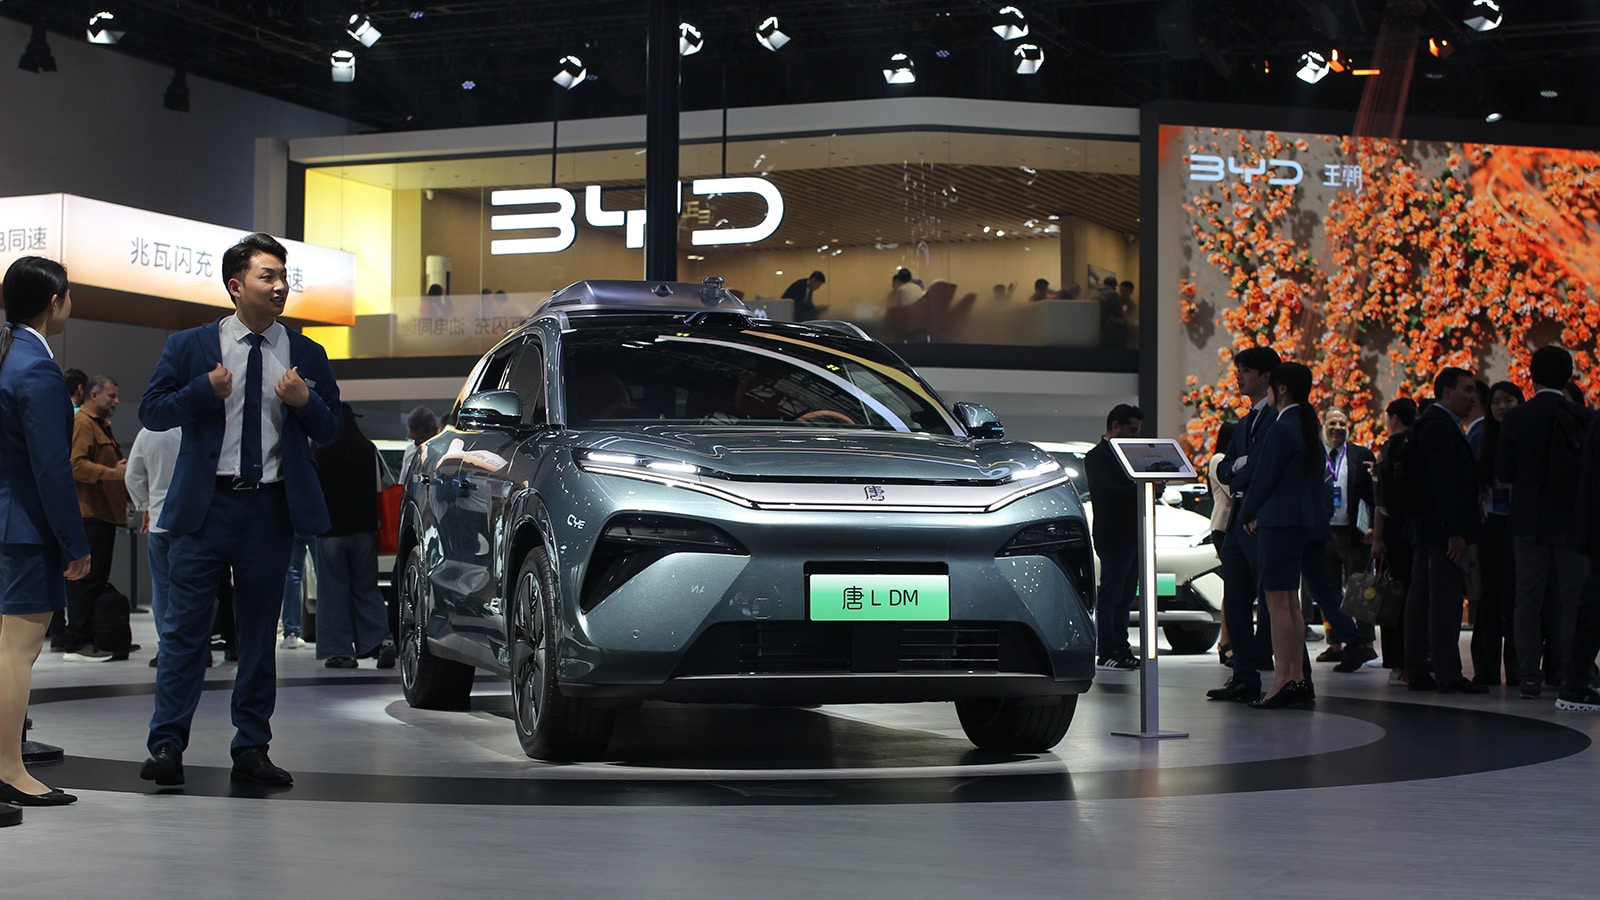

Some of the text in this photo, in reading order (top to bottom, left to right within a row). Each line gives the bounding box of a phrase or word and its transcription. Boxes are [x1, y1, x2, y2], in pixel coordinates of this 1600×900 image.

[1190, 154, 1304, 186] BYD
[491, 177, 785, 255] BYD
[132, 236, 213, 278] 兆瓦闪充
[842, 586, 918, 610] 唐 L DM
